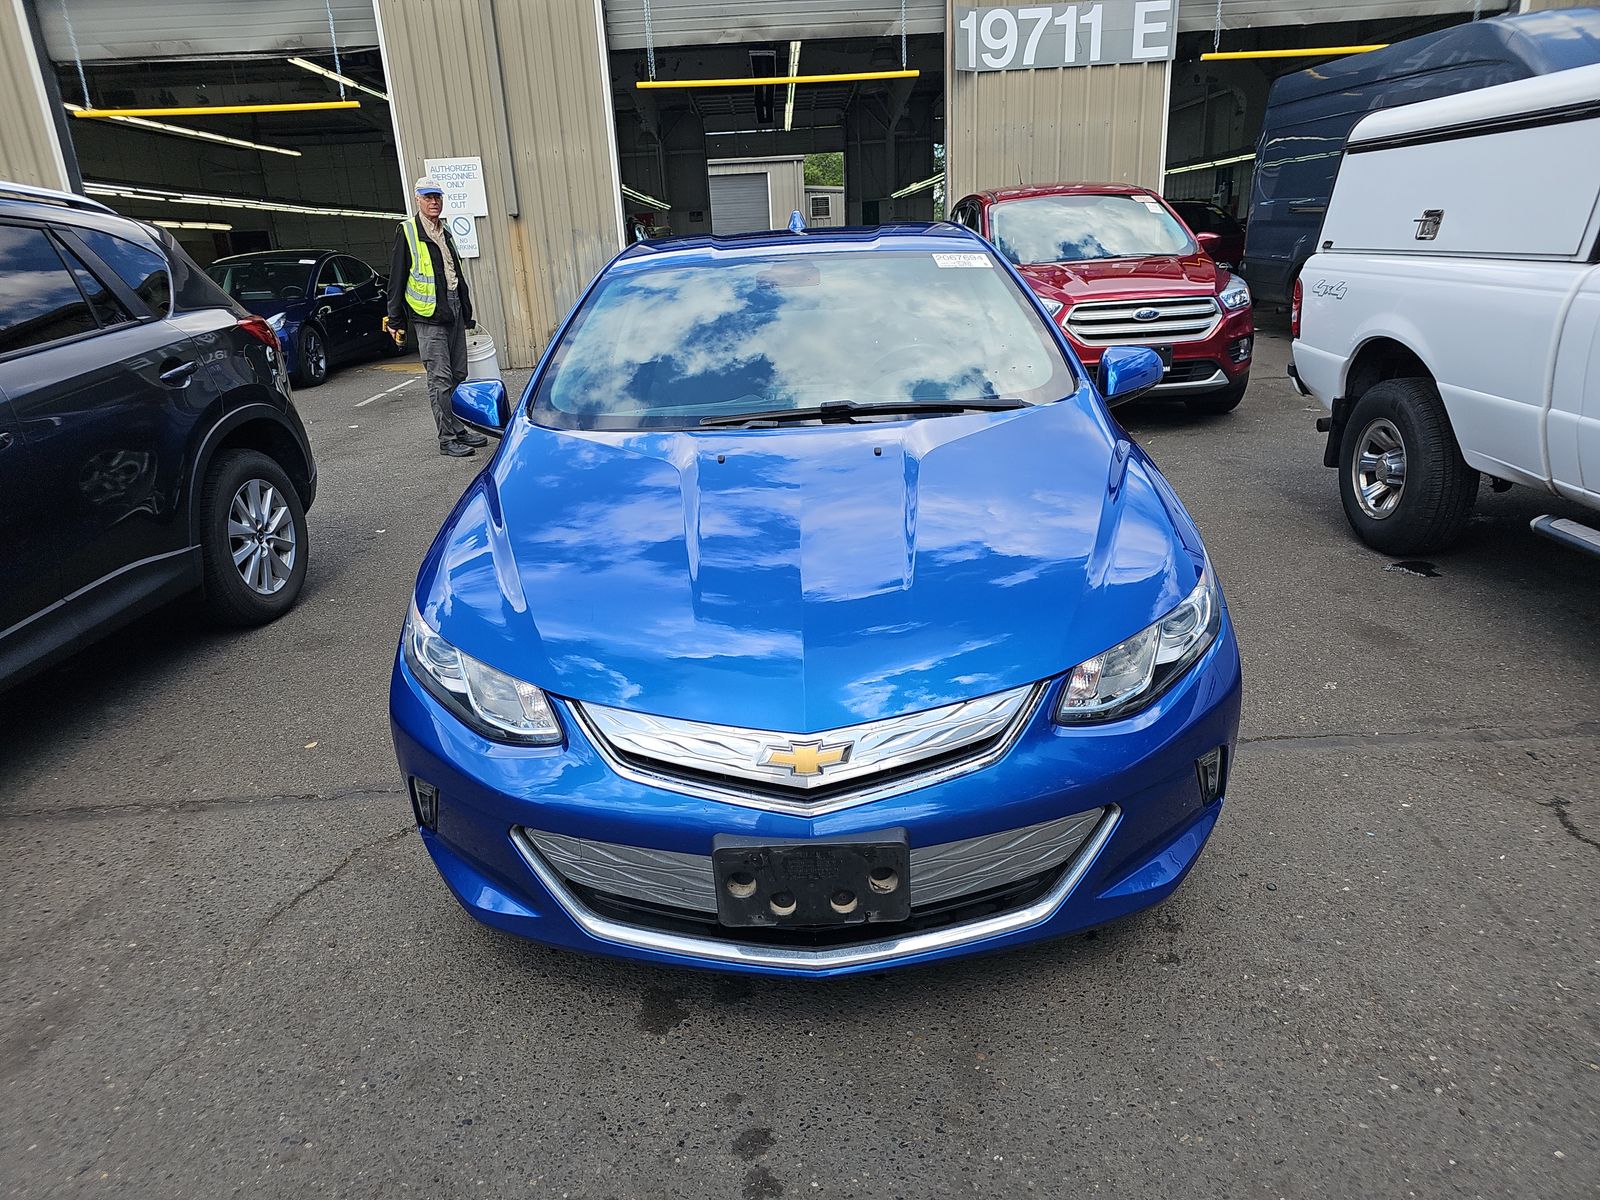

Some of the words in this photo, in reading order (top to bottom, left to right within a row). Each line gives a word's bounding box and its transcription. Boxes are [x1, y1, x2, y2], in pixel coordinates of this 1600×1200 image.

[960, 4, 1103, 68] 19711
[1132, 1, 1171, 59] E
[430, 164, 478, 173] AUTHORIZED
[432, 172, 478, 181] PERSONNEL
[446, 181, 465, 189] ONLY
[447, 193, 468, 201] KEEP
[1312, 279, 1348, 300] 4x4
